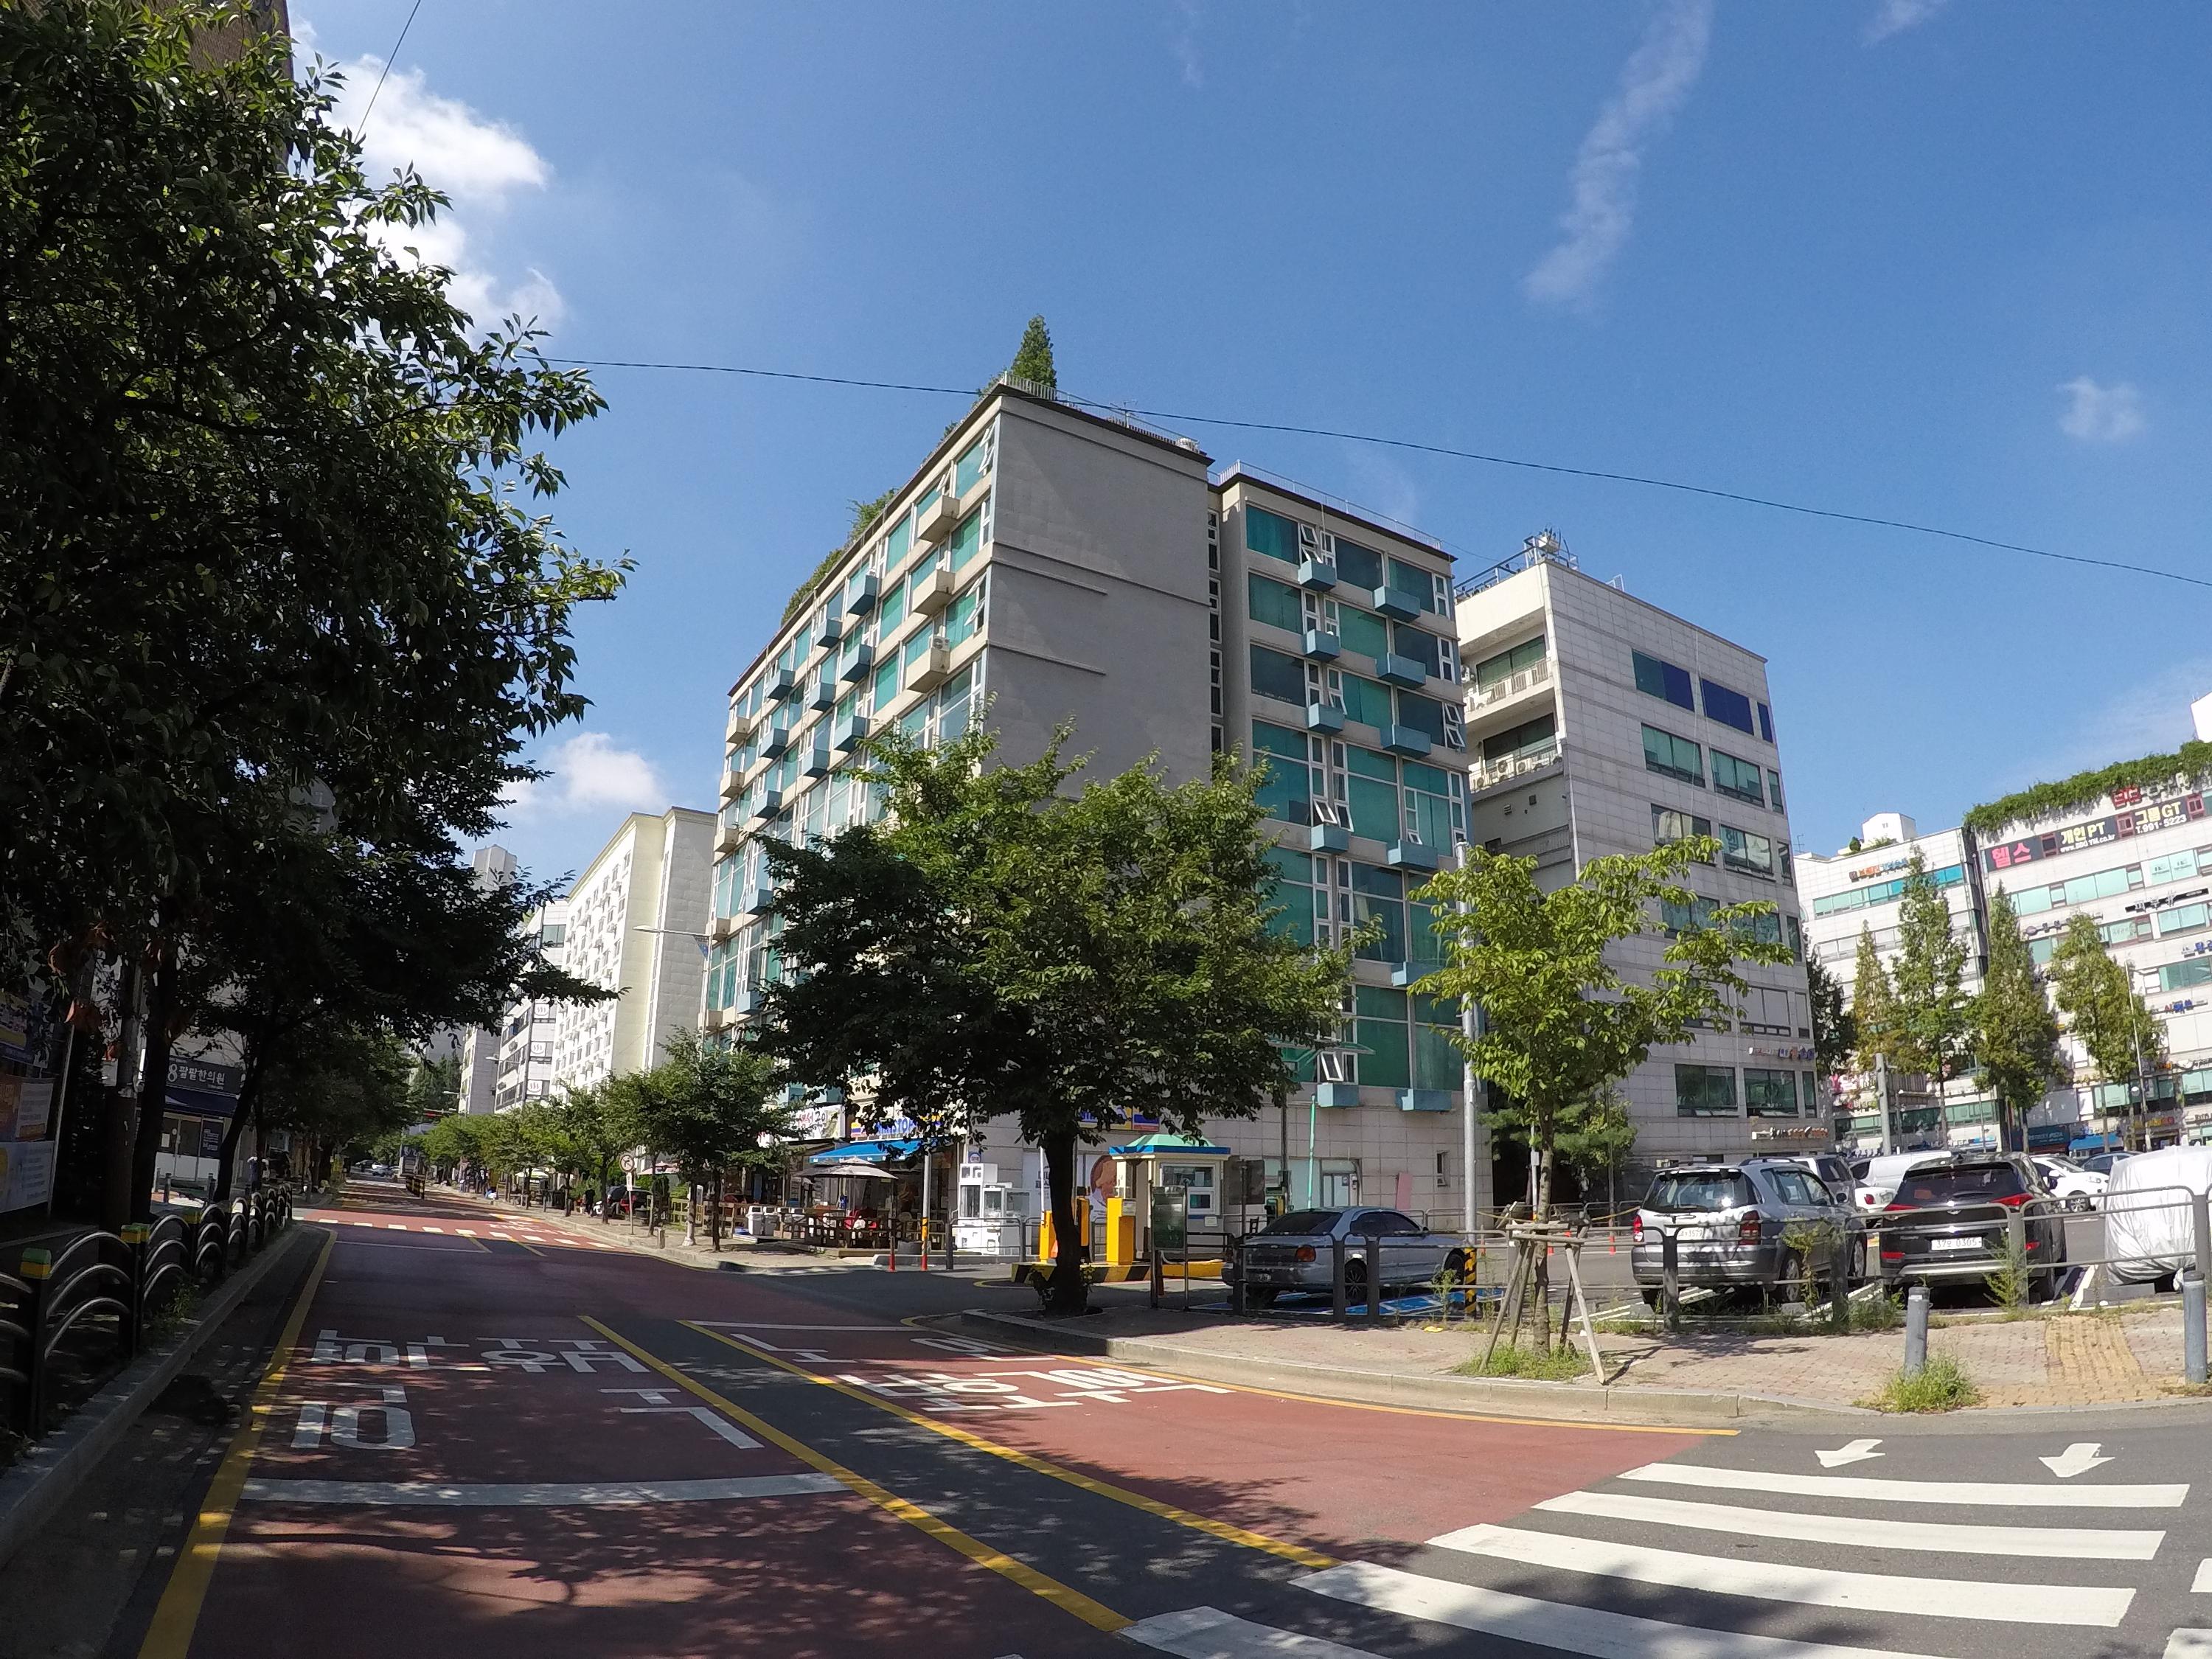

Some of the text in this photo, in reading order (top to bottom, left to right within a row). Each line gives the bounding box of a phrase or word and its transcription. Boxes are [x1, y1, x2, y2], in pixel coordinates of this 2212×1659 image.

[2162, 801, 2181, 818] GT
[2061, 821, 2106, 845] 개인 PT
[1992, 842, 2031, 869] 헬스
[311, 1329, 652, 1374] 보호구역
[838, 1367, 1236, 1412] 보호구역
